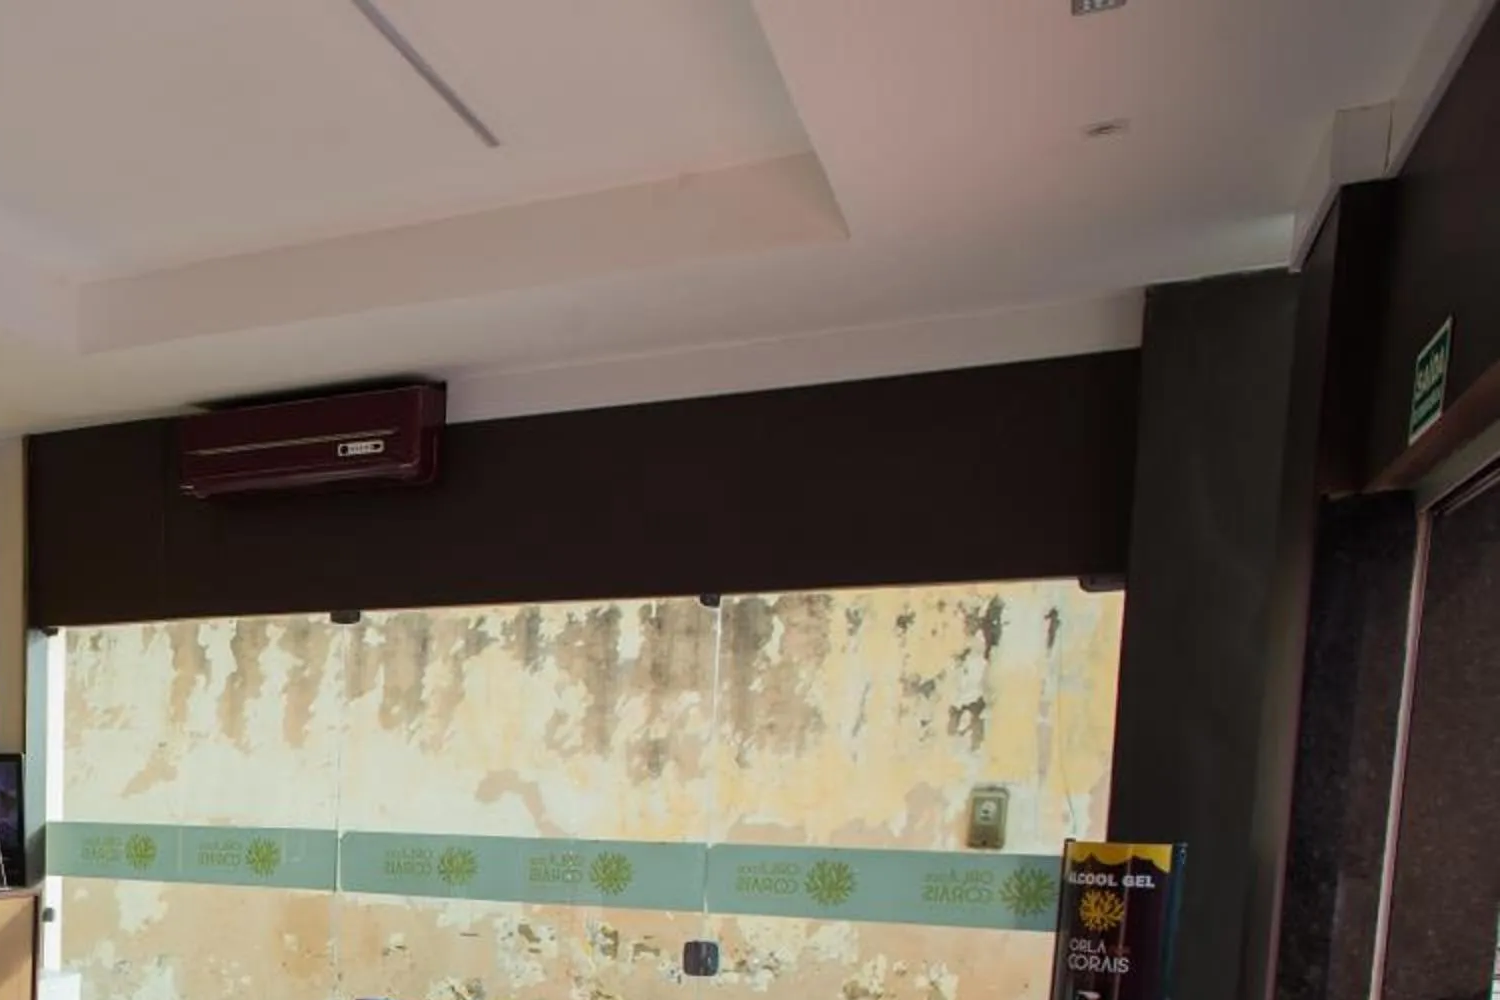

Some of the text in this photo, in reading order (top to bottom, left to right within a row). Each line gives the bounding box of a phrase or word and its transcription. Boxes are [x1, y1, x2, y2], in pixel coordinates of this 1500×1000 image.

[1122, 874, 1156, 889] GEL
[1069, 936, 1108, 955] ORLA
[1067, 952, 1131, 974] CORAIS
